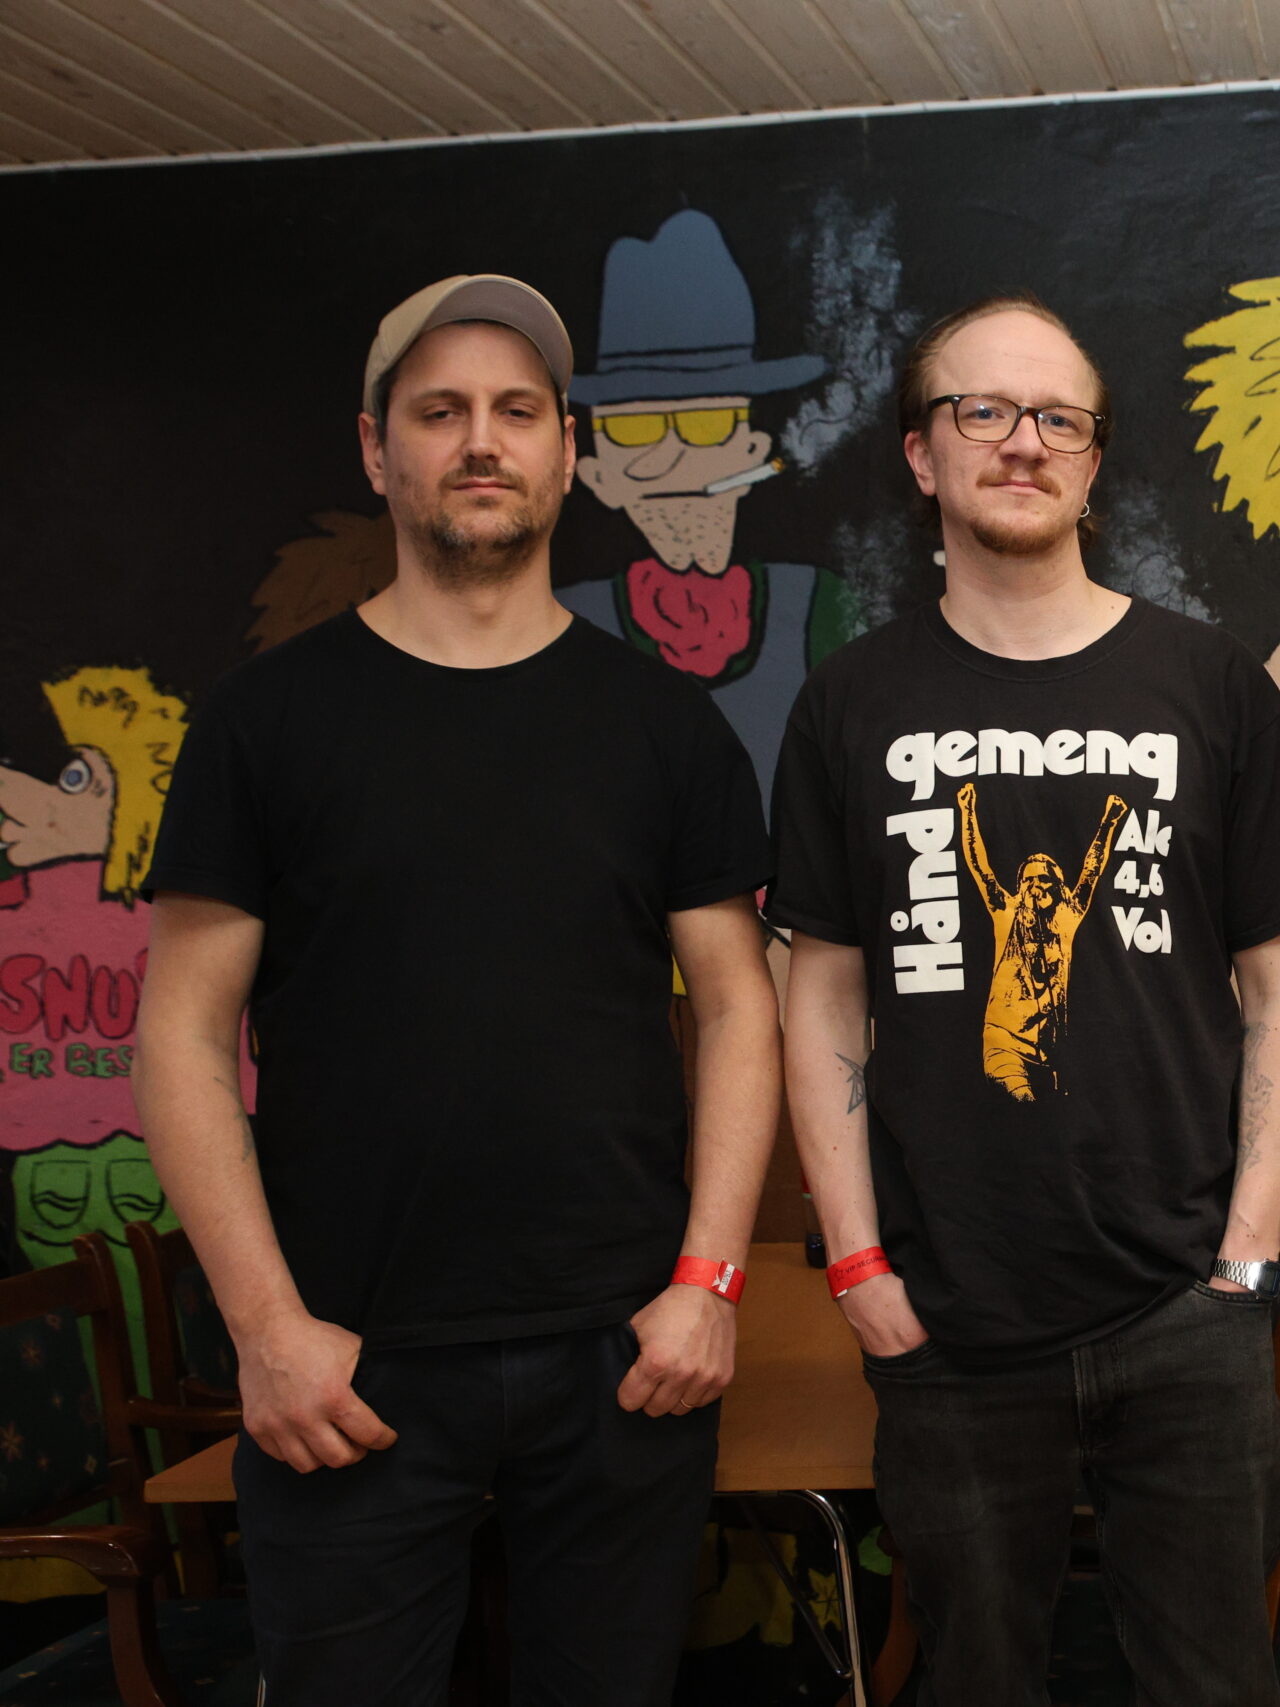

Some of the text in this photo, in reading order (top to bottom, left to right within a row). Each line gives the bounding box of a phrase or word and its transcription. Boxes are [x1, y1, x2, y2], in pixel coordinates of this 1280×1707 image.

[1111, 905, 1172, 954] Vol
[0, 948, 148, 1042] SNU
[9, 1042, 54, 1079] ER
